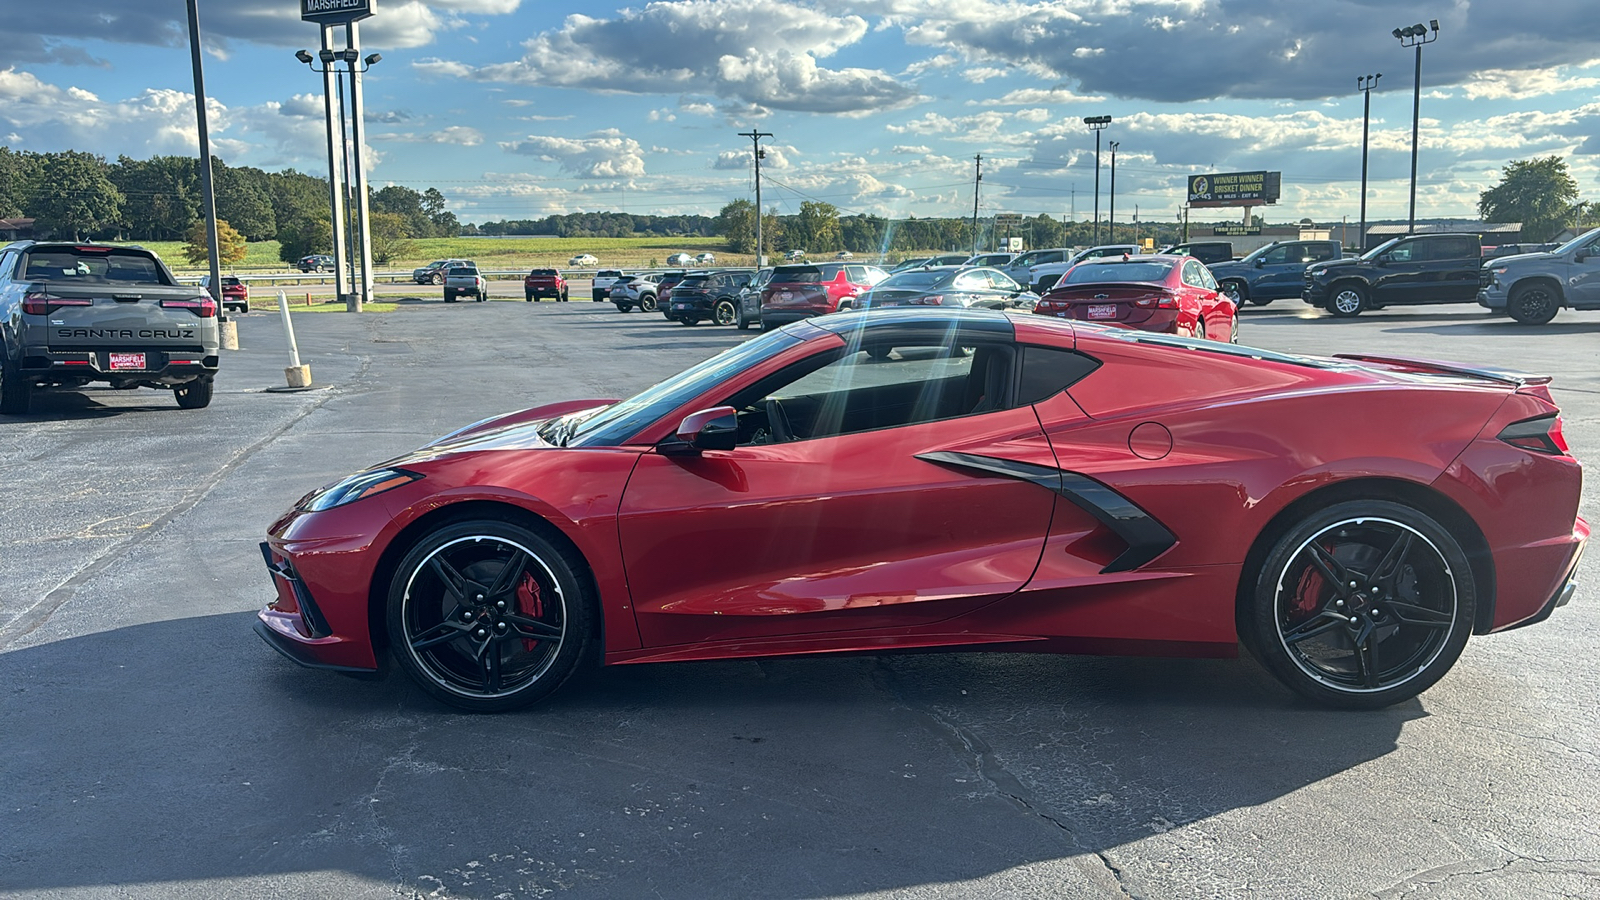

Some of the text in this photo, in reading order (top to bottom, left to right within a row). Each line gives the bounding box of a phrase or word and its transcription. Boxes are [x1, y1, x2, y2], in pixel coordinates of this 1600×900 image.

[307, 0, 359, 11] MARSHFIELD
[1213, 174, 1263, 184] WINNER WINNER
[1214, 183, 1262, 193] BRISKET DINNER
[58, 329, 194, 338] SANTA CRUZ
[110, 355, 146, 363] MARSHFIELD
